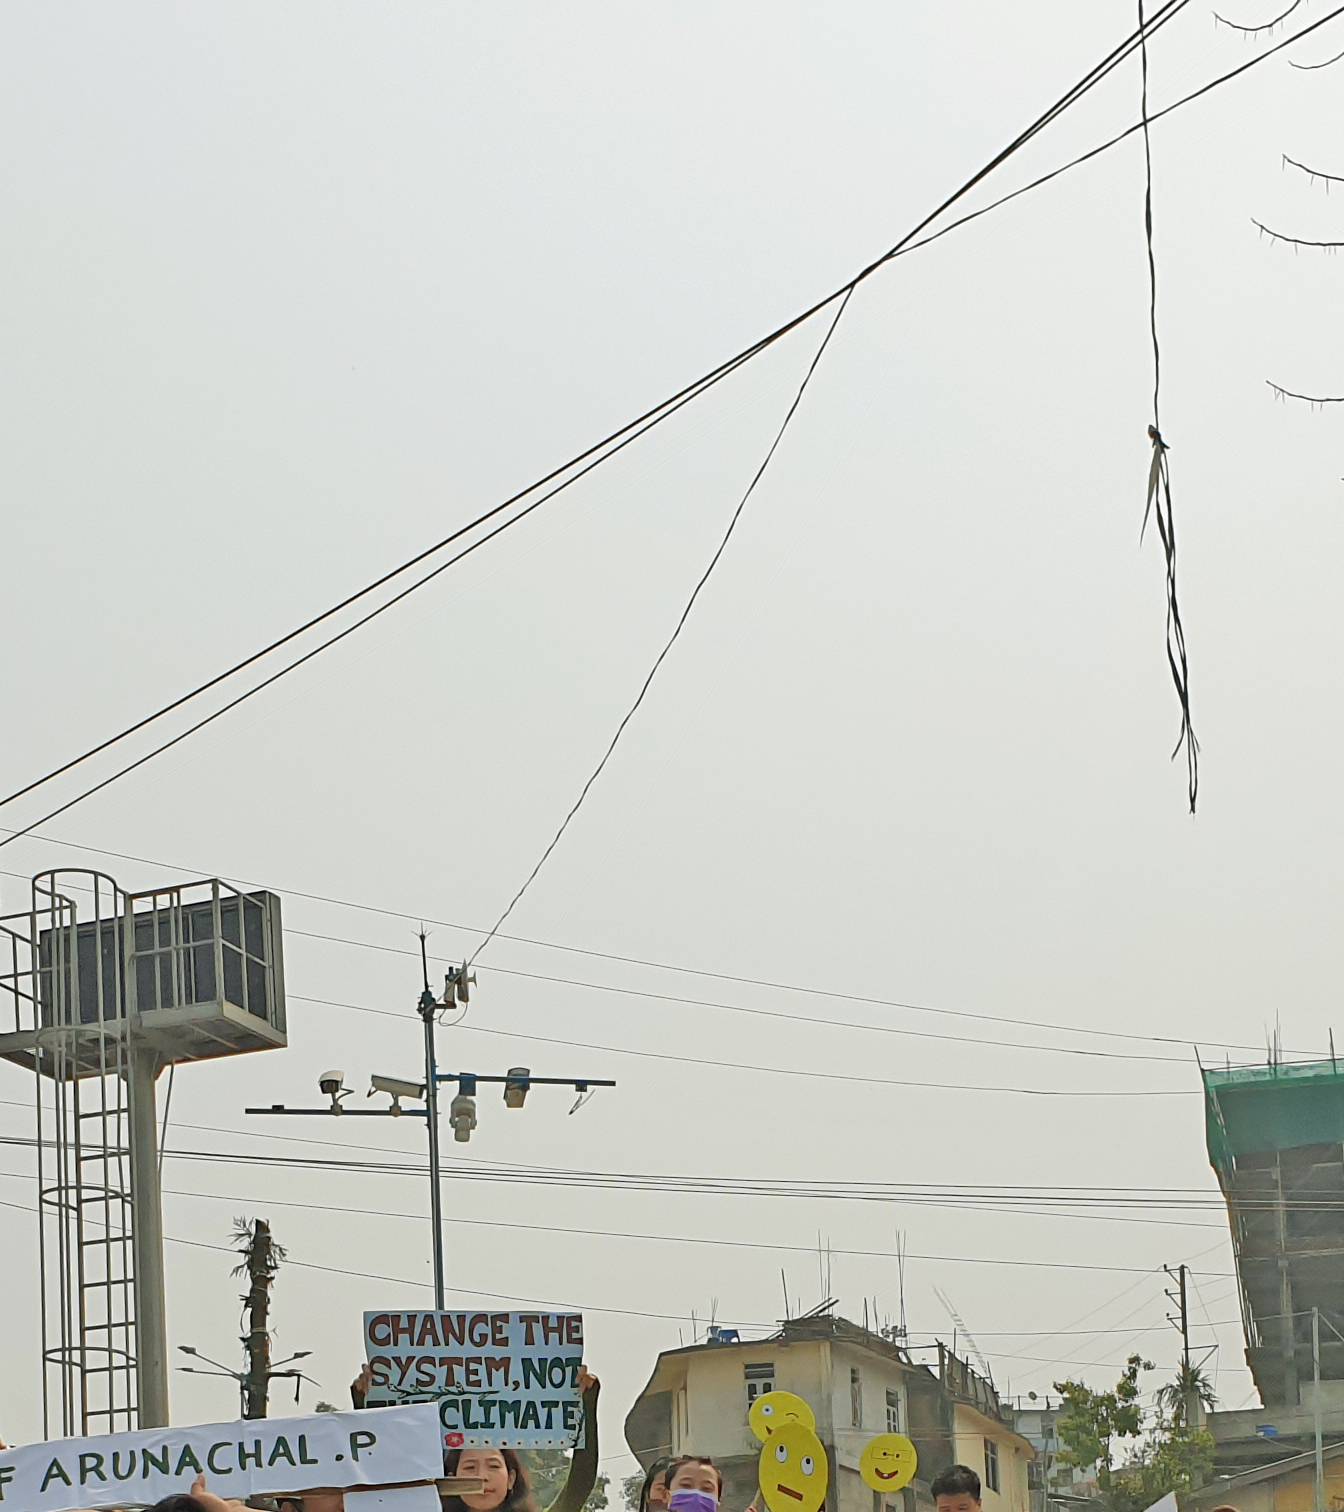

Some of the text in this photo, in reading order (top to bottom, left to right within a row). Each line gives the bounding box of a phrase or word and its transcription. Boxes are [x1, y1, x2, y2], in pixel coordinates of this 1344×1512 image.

[369, 1314, 583, 1347] CHANGE THE
[440, 1399, 580, 1431] CLIMATE
[39, 1431, 318, 1492] ARUNACHAL
